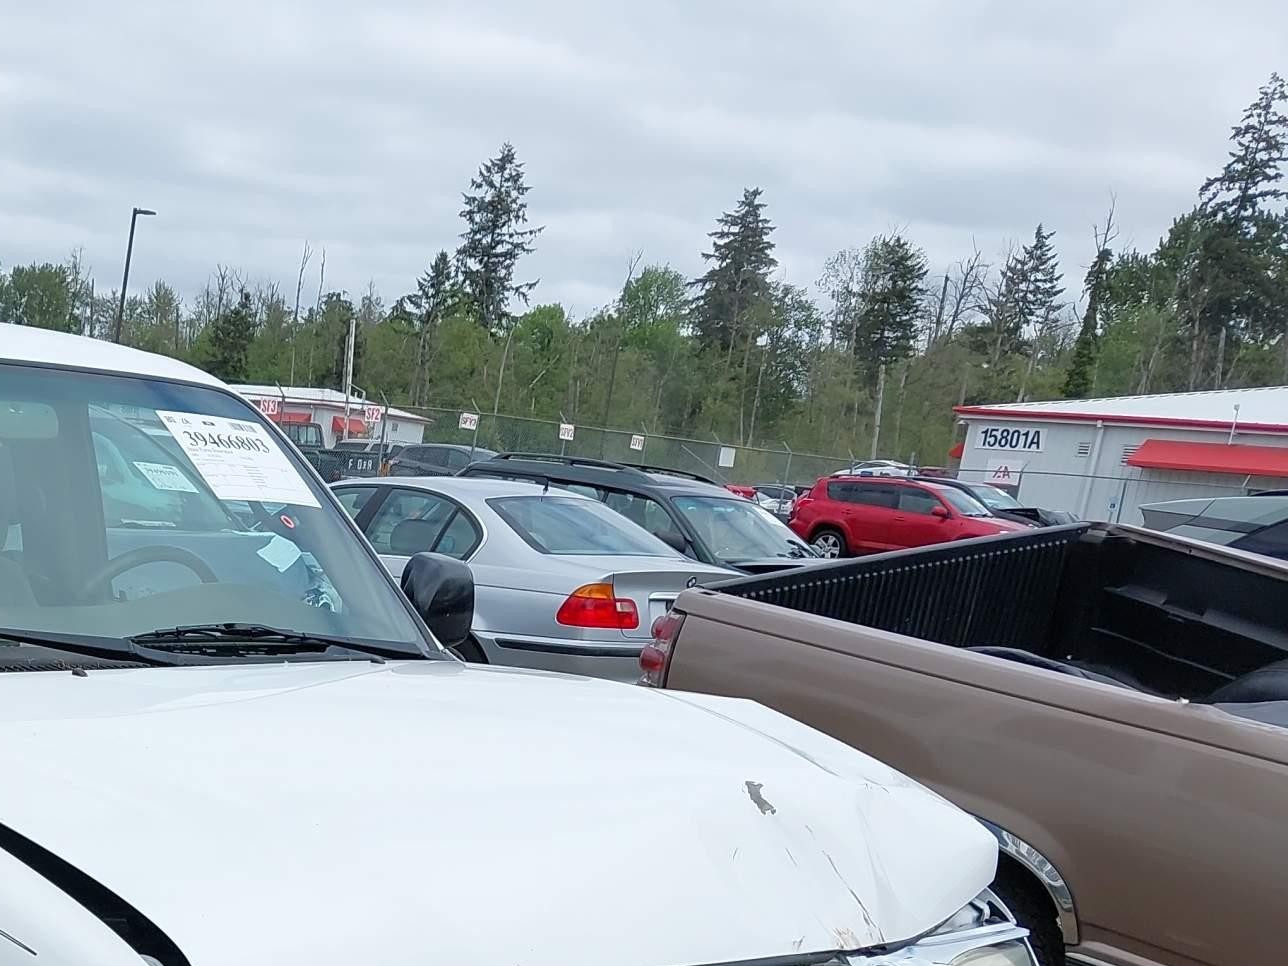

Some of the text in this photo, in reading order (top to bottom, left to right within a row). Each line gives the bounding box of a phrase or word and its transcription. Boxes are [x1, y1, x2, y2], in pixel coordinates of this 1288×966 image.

[261, 399, 277, 414] SF3
[366, 407, 381, 421] SF2
[183, 431, 270, 454] 39466803
[981, 428, 1041, 450] 15801A
